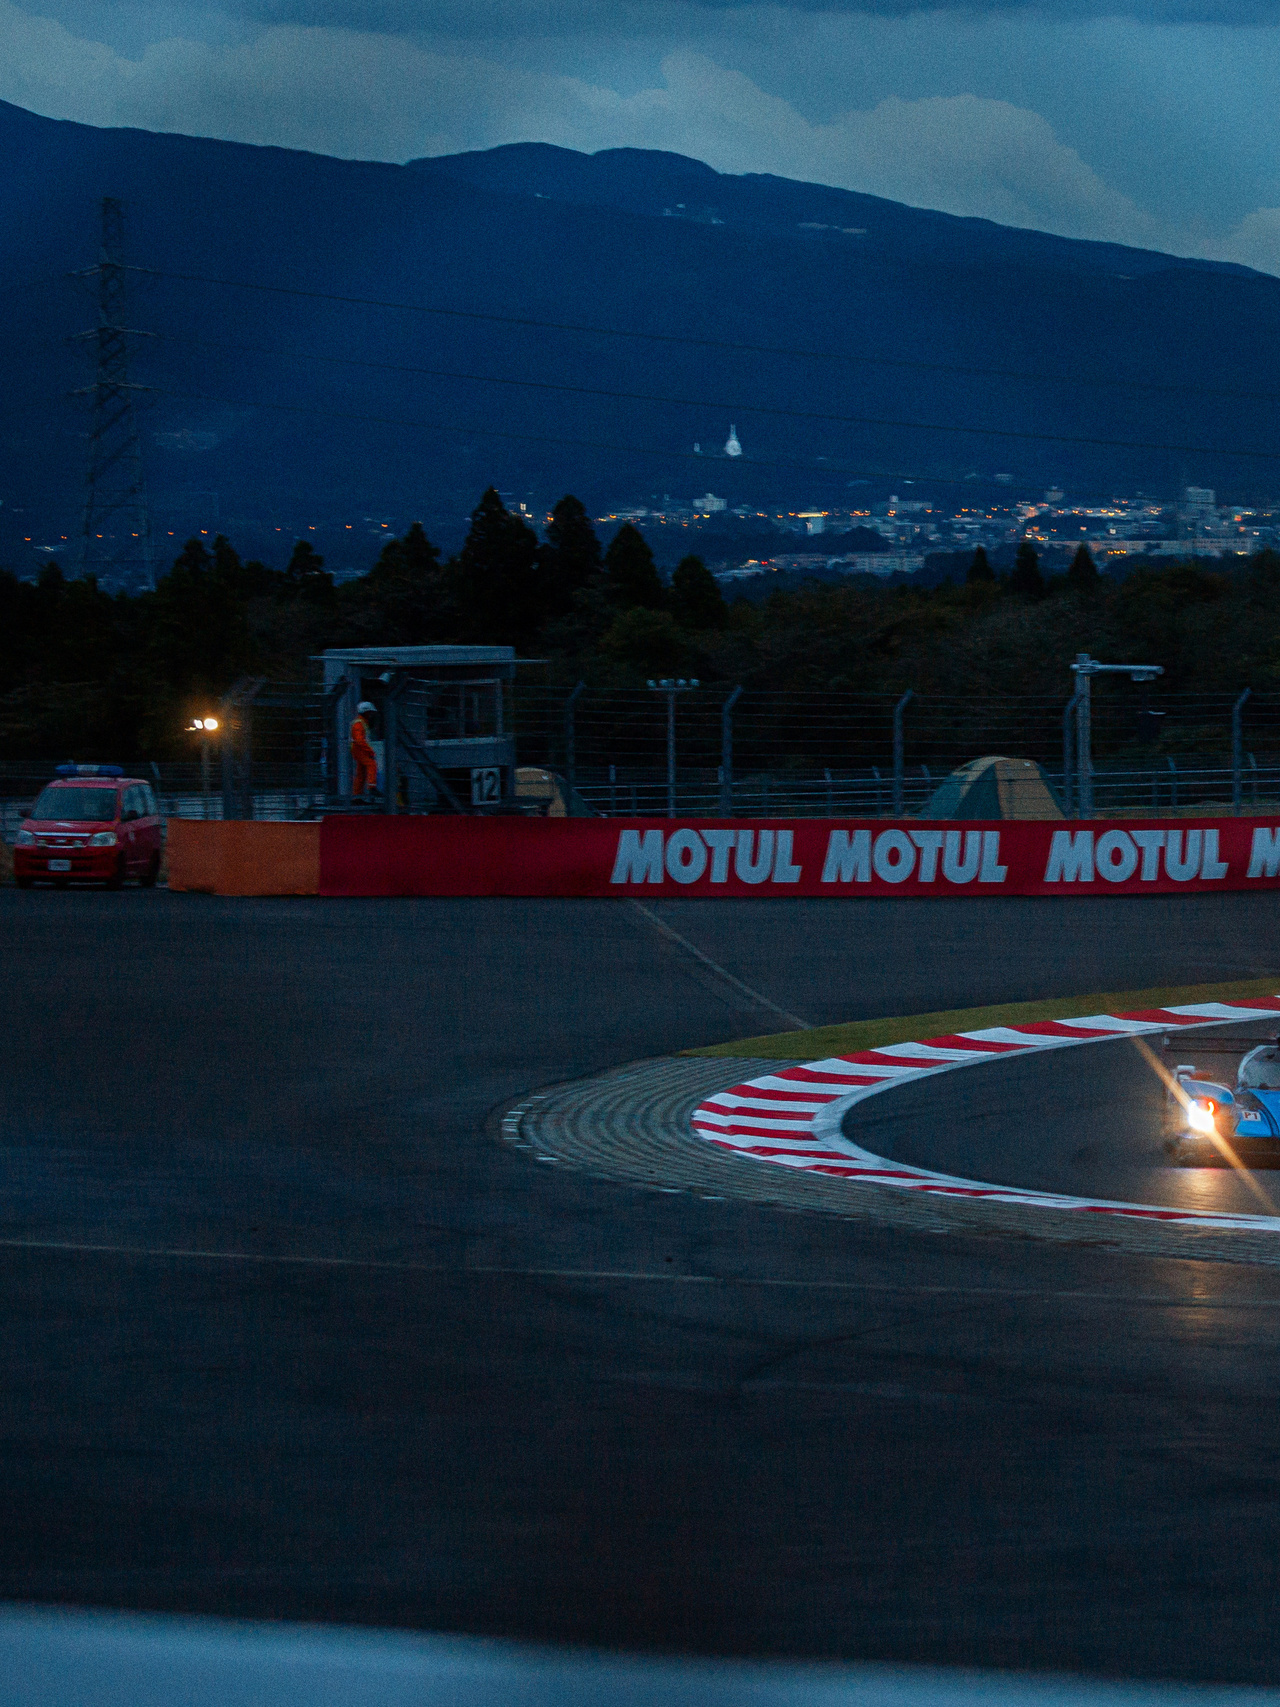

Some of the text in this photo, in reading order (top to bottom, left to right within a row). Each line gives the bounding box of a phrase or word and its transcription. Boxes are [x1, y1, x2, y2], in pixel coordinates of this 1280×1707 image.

[475, 771, 496, 801] 12
[610, 828, 803, 884] MOTUL
[820, 828, 1009, 884] MOTUL
[1043, 828, 1230, 883] MOTUL
